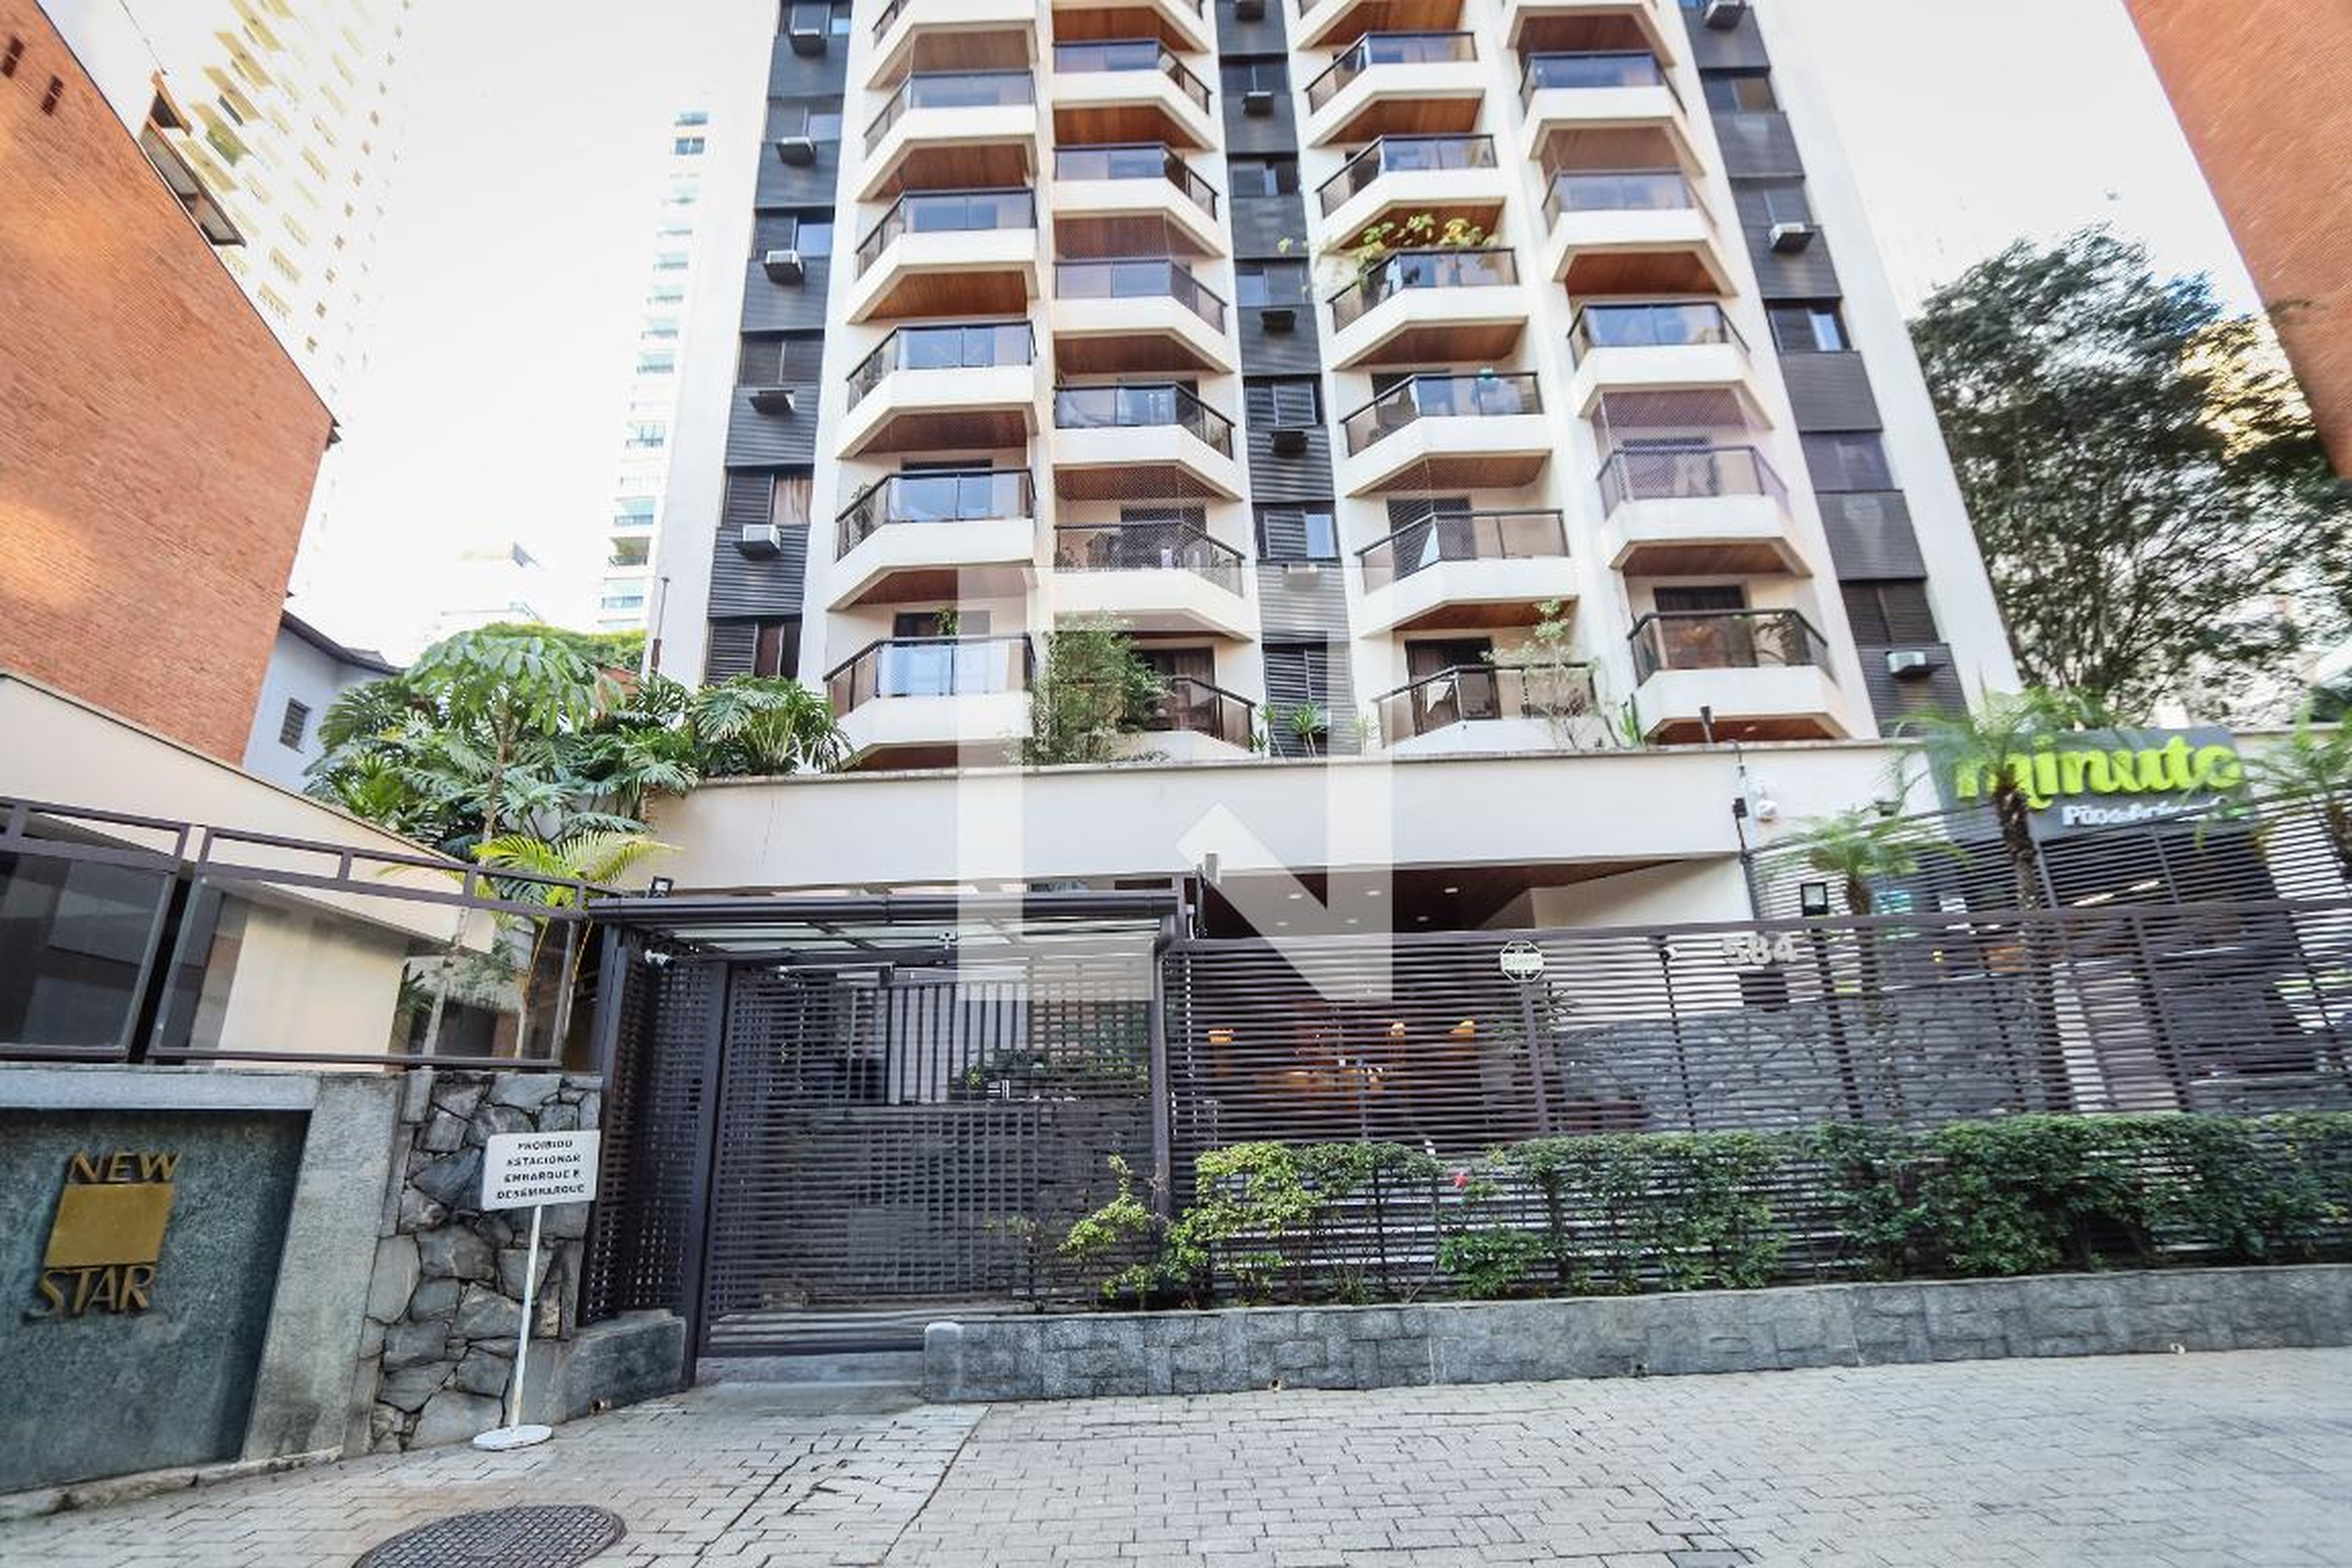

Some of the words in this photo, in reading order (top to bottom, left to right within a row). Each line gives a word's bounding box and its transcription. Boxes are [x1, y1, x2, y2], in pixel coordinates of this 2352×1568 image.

[1955, 735, 2243, 809] minute
[1722, 935, 1797, 965] 584
[517, 1139, 573, 1150] PROIBIDO
[67, 1150, 182, 1182] NEW
[507, 1154, 581, 1167] ESTACIONAR
[504, 1169, 570, 1183] EMBARQUE
[573, 1169, 581, 1178] E
[497, 1184, 585, 1200] DESEMBARQUE
[28, 1265, 154, 1317] STAR
